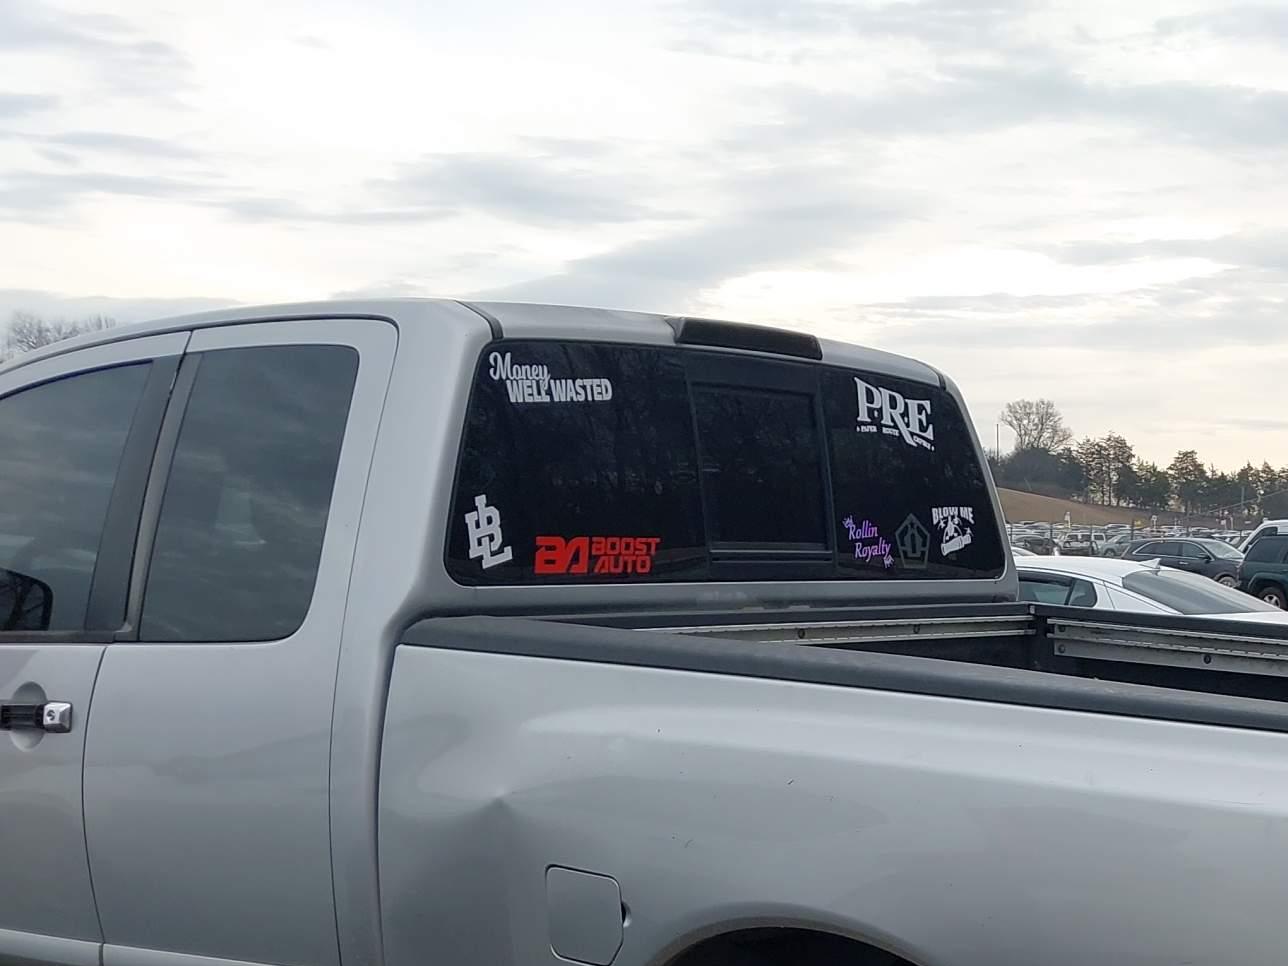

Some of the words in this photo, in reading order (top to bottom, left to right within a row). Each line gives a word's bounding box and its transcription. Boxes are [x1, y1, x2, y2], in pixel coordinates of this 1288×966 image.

[489, 352, 550, 390] Money
[506, 380, 550, 402] WELL
[550, 378, 612, 402] WASTED
[932, 507, 958, 525] BLOW
[960, 507, 975, 524] ME
[849, 520, 878, 541] Rollin
[592, 537, 660, 555] BOOST
[855, 537, 891, 562] Royalty
[593, 555, 651, 574] AUTO
